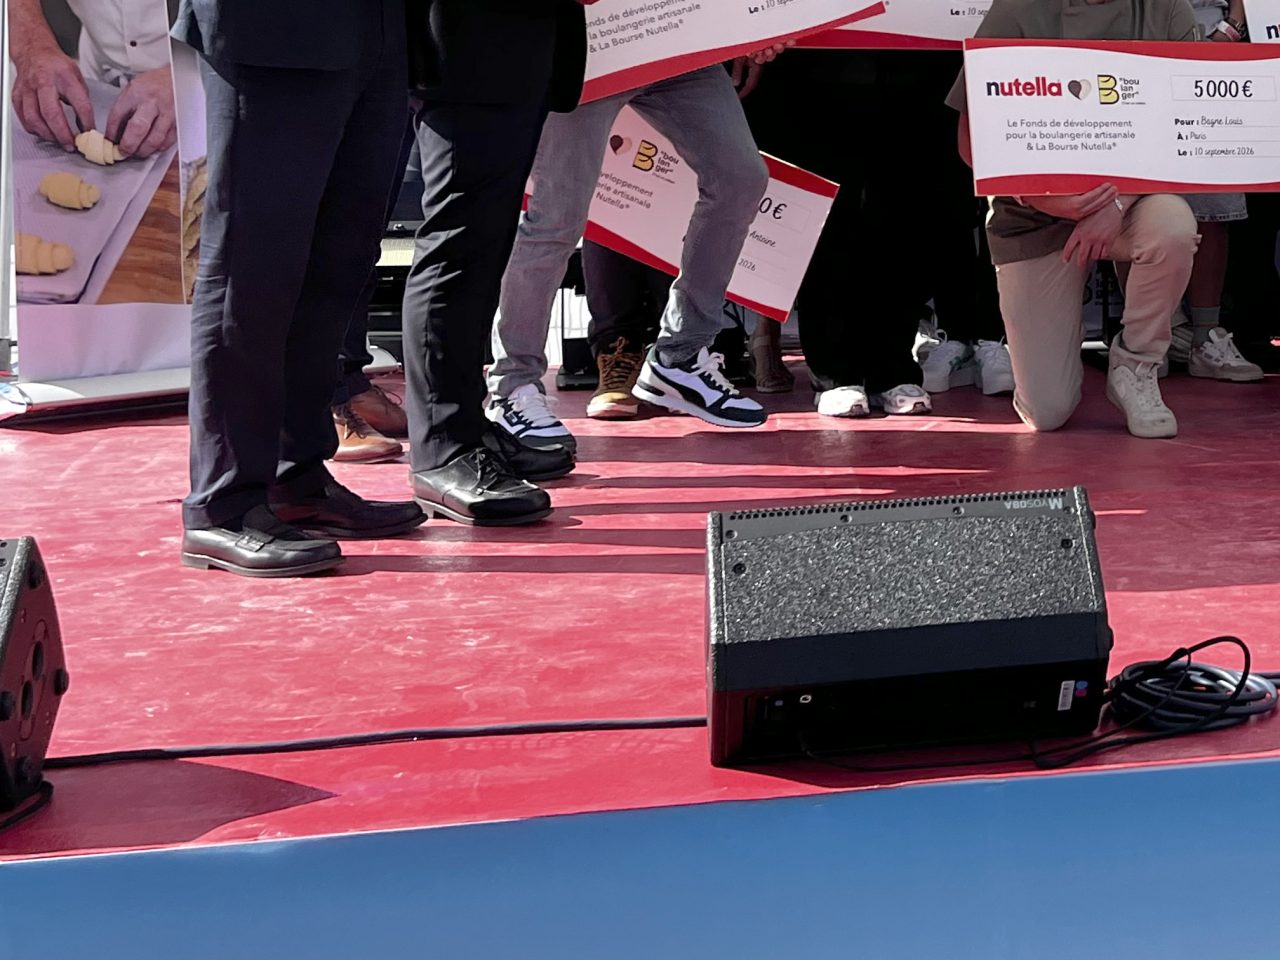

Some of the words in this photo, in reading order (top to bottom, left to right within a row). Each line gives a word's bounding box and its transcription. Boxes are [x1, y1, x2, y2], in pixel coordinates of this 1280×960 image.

[749, 6, 759, 14] Le
[1007, 119, 1018, 128] Le
[1020, 119, 1047, 128] Fonds
[1049, 120, 1061, 128] de
[1063, 119, 1132, 130] développement
[1174, 118, 1195, 126] Pour
[1006, 132, 1027, 141] pour
[1029, 131, 1037, 139] la
[1039, 131, 1092, 142] boulangerie
[1094, 131, 1135, 140] artisanale
[1036, 143, 1046, 151] La
[1048, 142, 1079, 151] Bourse
